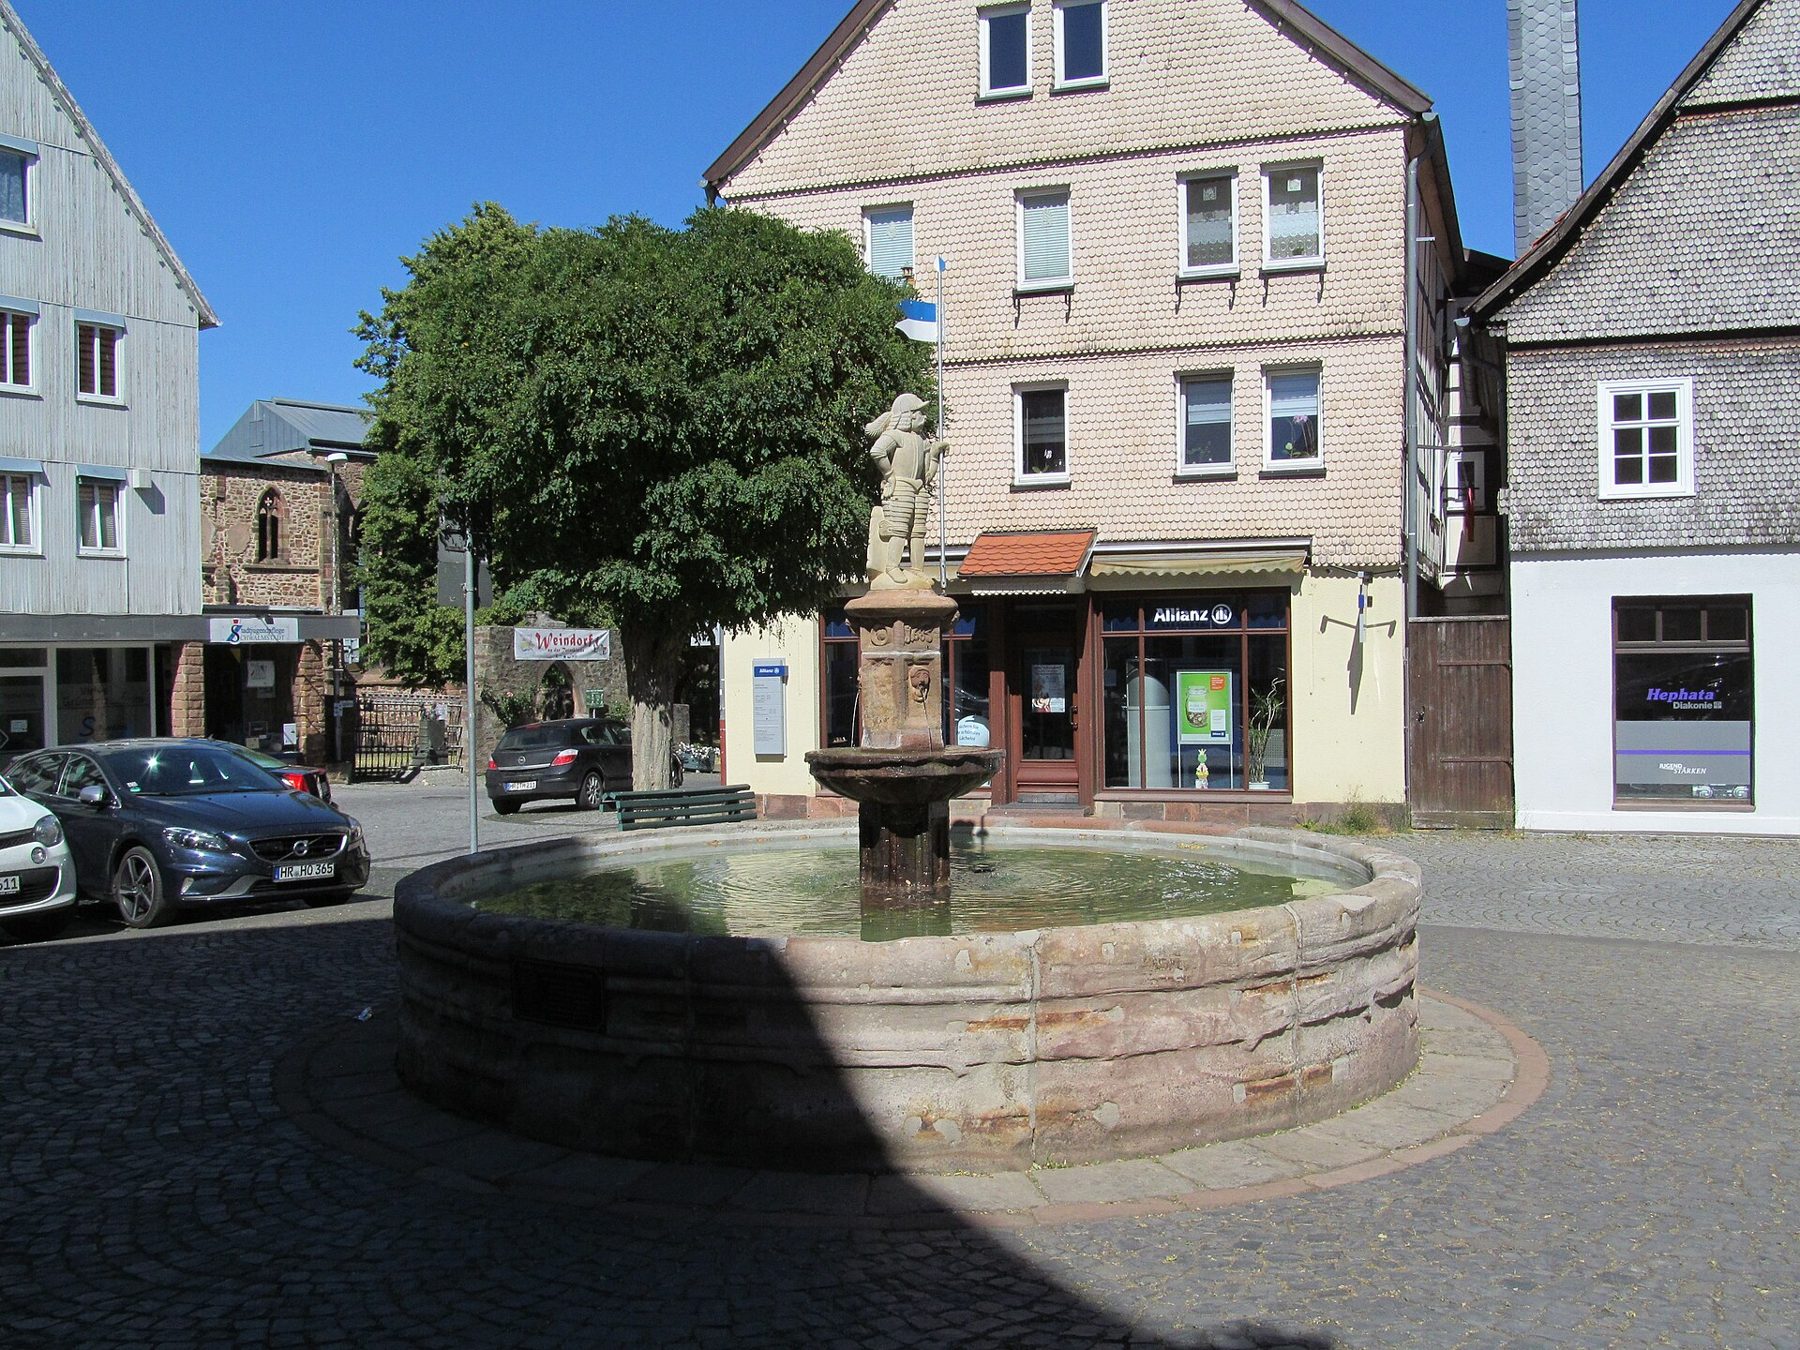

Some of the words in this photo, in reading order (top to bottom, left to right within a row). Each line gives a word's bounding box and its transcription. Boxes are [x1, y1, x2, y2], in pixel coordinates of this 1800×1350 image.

[1153, 608, 1209, 622] Allianz
[535, 632, 593, 649] Weindorf
[1646, 688, 1714, 703] Hephata
[1672, 702, 1713, 710] Diakonie
[1673, 766, 1707, 775] STÄRKEN
[281, 866, 293, 878] HR
[301, 864, 313, 876] HO
[315, 862, 333, 875] 365
